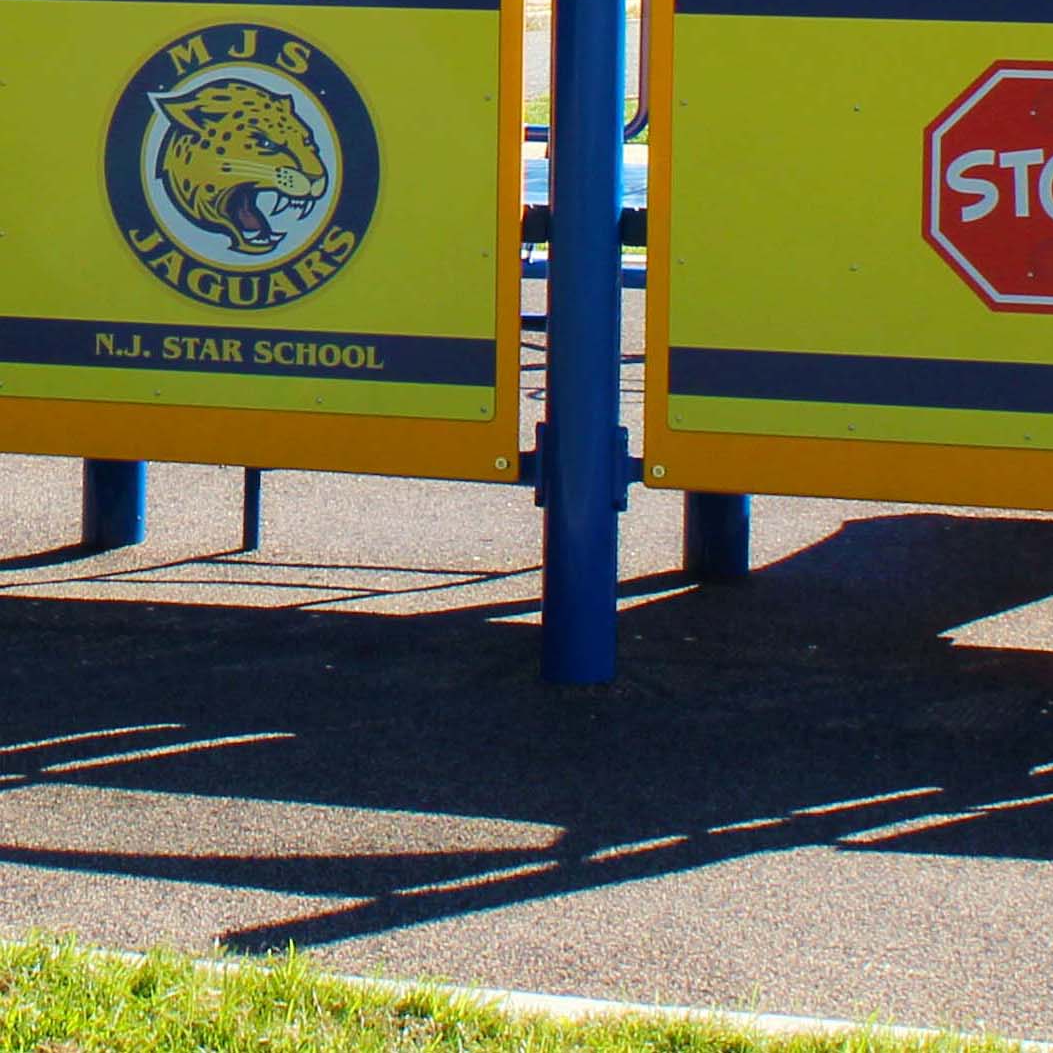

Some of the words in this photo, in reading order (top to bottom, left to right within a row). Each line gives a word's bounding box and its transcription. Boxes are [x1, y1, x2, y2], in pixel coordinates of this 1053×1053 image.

[130, 226, 356, 306] JAGUARS
[95, 333, 151, 358] N.J.
[162, 338, 244, 362] STAR
[254, 342, 384, 369] SCHOOL
